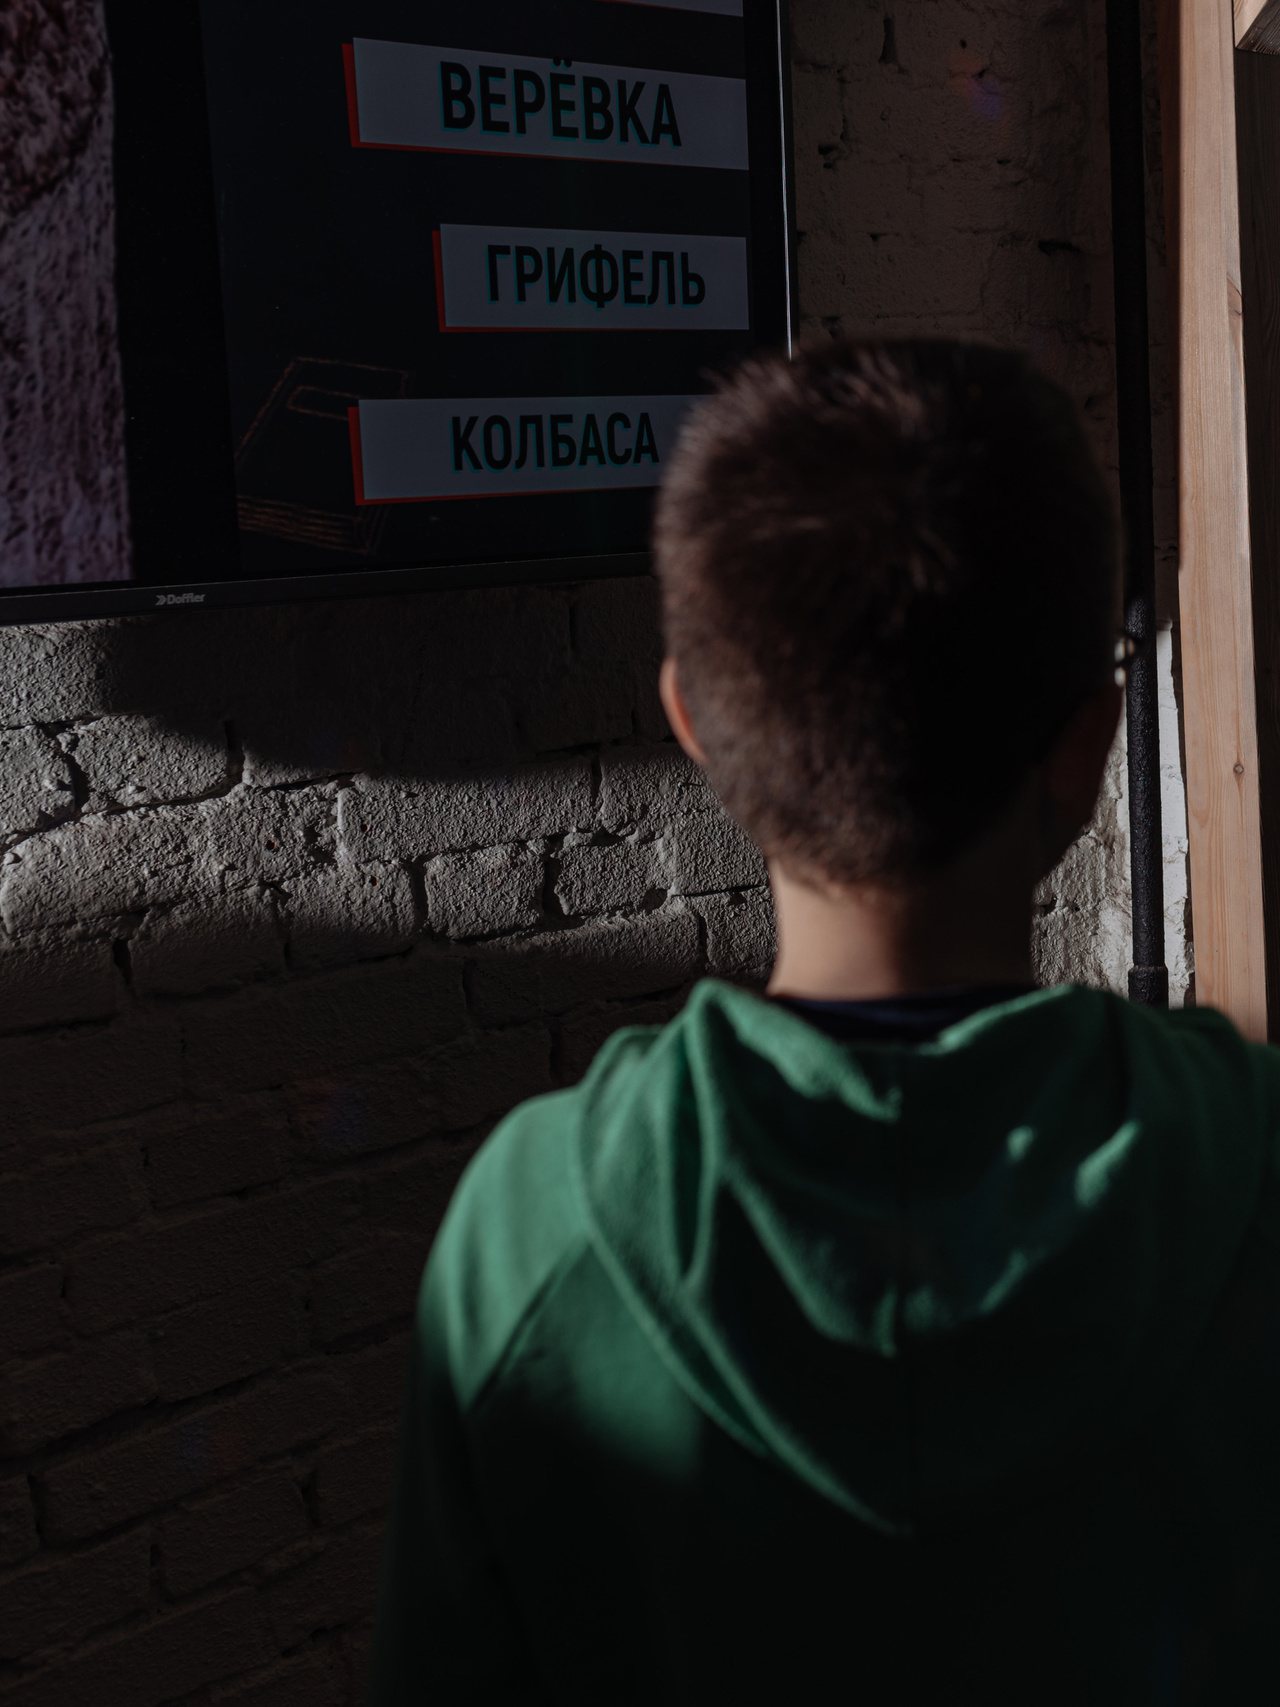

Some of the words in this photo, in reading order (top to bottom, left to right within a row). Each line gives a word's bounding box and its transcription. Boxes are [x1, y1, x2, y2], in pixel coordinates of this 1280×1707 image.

[439, 57, 683, 148] ВЕРЁВКА
[486, 244, 707, 310] ГРИФЕЛЬ
[450, 411, 660, 475] КОЛБАСА
[166, 592, 206, 605] Doffler
